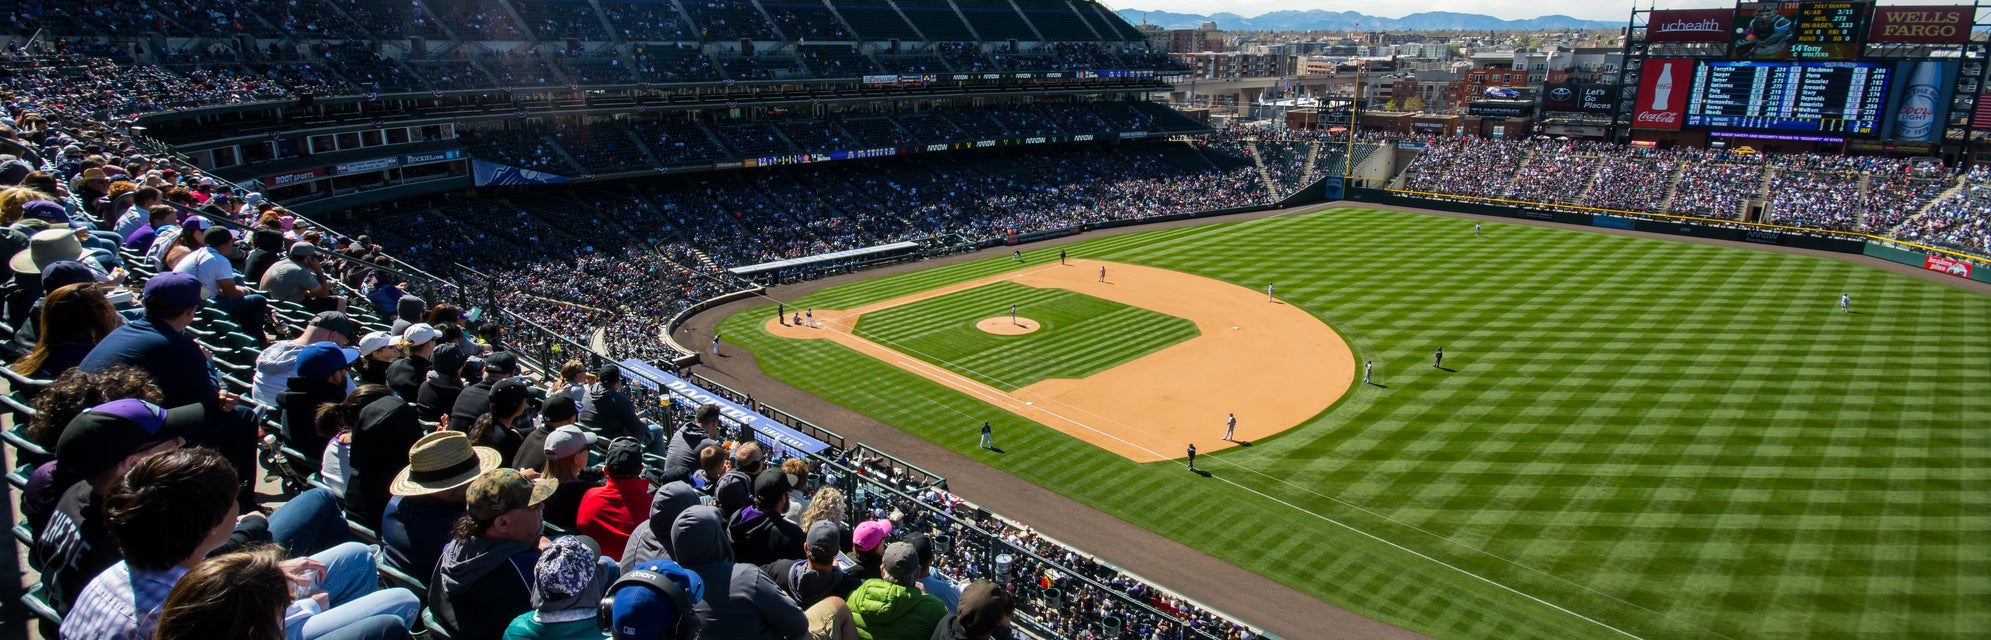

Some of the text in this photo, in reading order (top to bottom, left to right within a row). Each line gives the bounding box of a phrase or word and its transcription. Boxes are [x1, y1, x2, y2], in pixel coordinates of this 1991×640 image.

[1886, 12, 1960, 23] WELLS
[1662, 19, 1719, 31] uchealth
[1882, 25, 1956, 36] FARGO
[275, 172, 314, 184] ROOT SPORTS
[1747, 231, 1778, 239] ARROW
